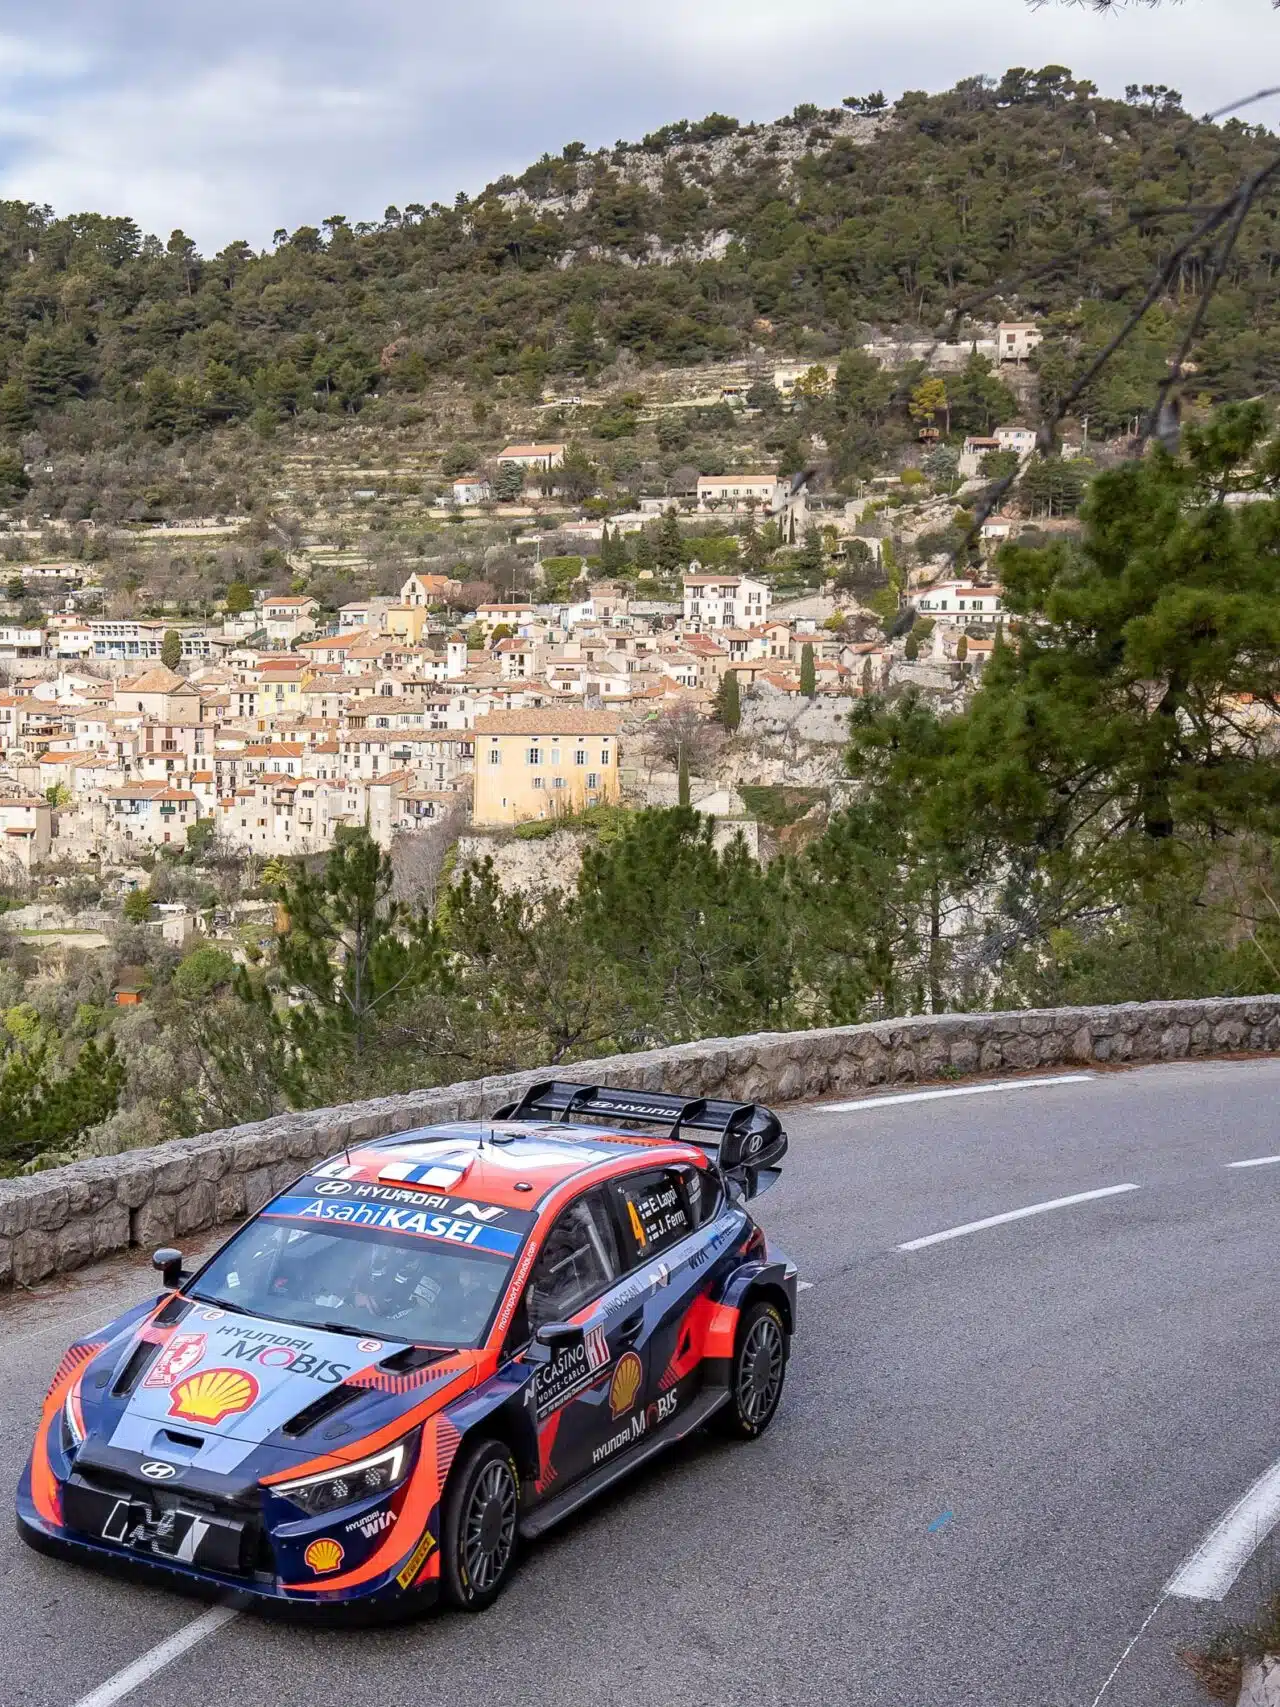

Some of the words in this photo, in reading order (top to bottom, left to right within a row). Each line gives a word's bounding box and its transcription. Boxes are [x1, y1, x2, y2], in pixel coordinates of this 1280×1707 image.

[329, 1165, 351, 1178] 4
[354, 1185, 450, 1210] HYUNDAI
[656, 1185, 678, 1209] Lappi
[626, 1200, 647, 1248] 4
[665, 1208, 686, 1228] Ferm
[498, 1241, 537, 1331] motorsport.hyundai.com
[603, 1284, 640, 1317] INNOCEAN
[216, 1325, 314, 1351] HYUNDAI
[221, 1340, 352, 1385] MOBIS
[542, 1343, 585, 1384] CASINO
[631, 1387, 678, 1442] MOBIS
[591, 1429, 630, 1465] HYUNDAI
[345, 1510, 380, 1533] HYUNDAI
